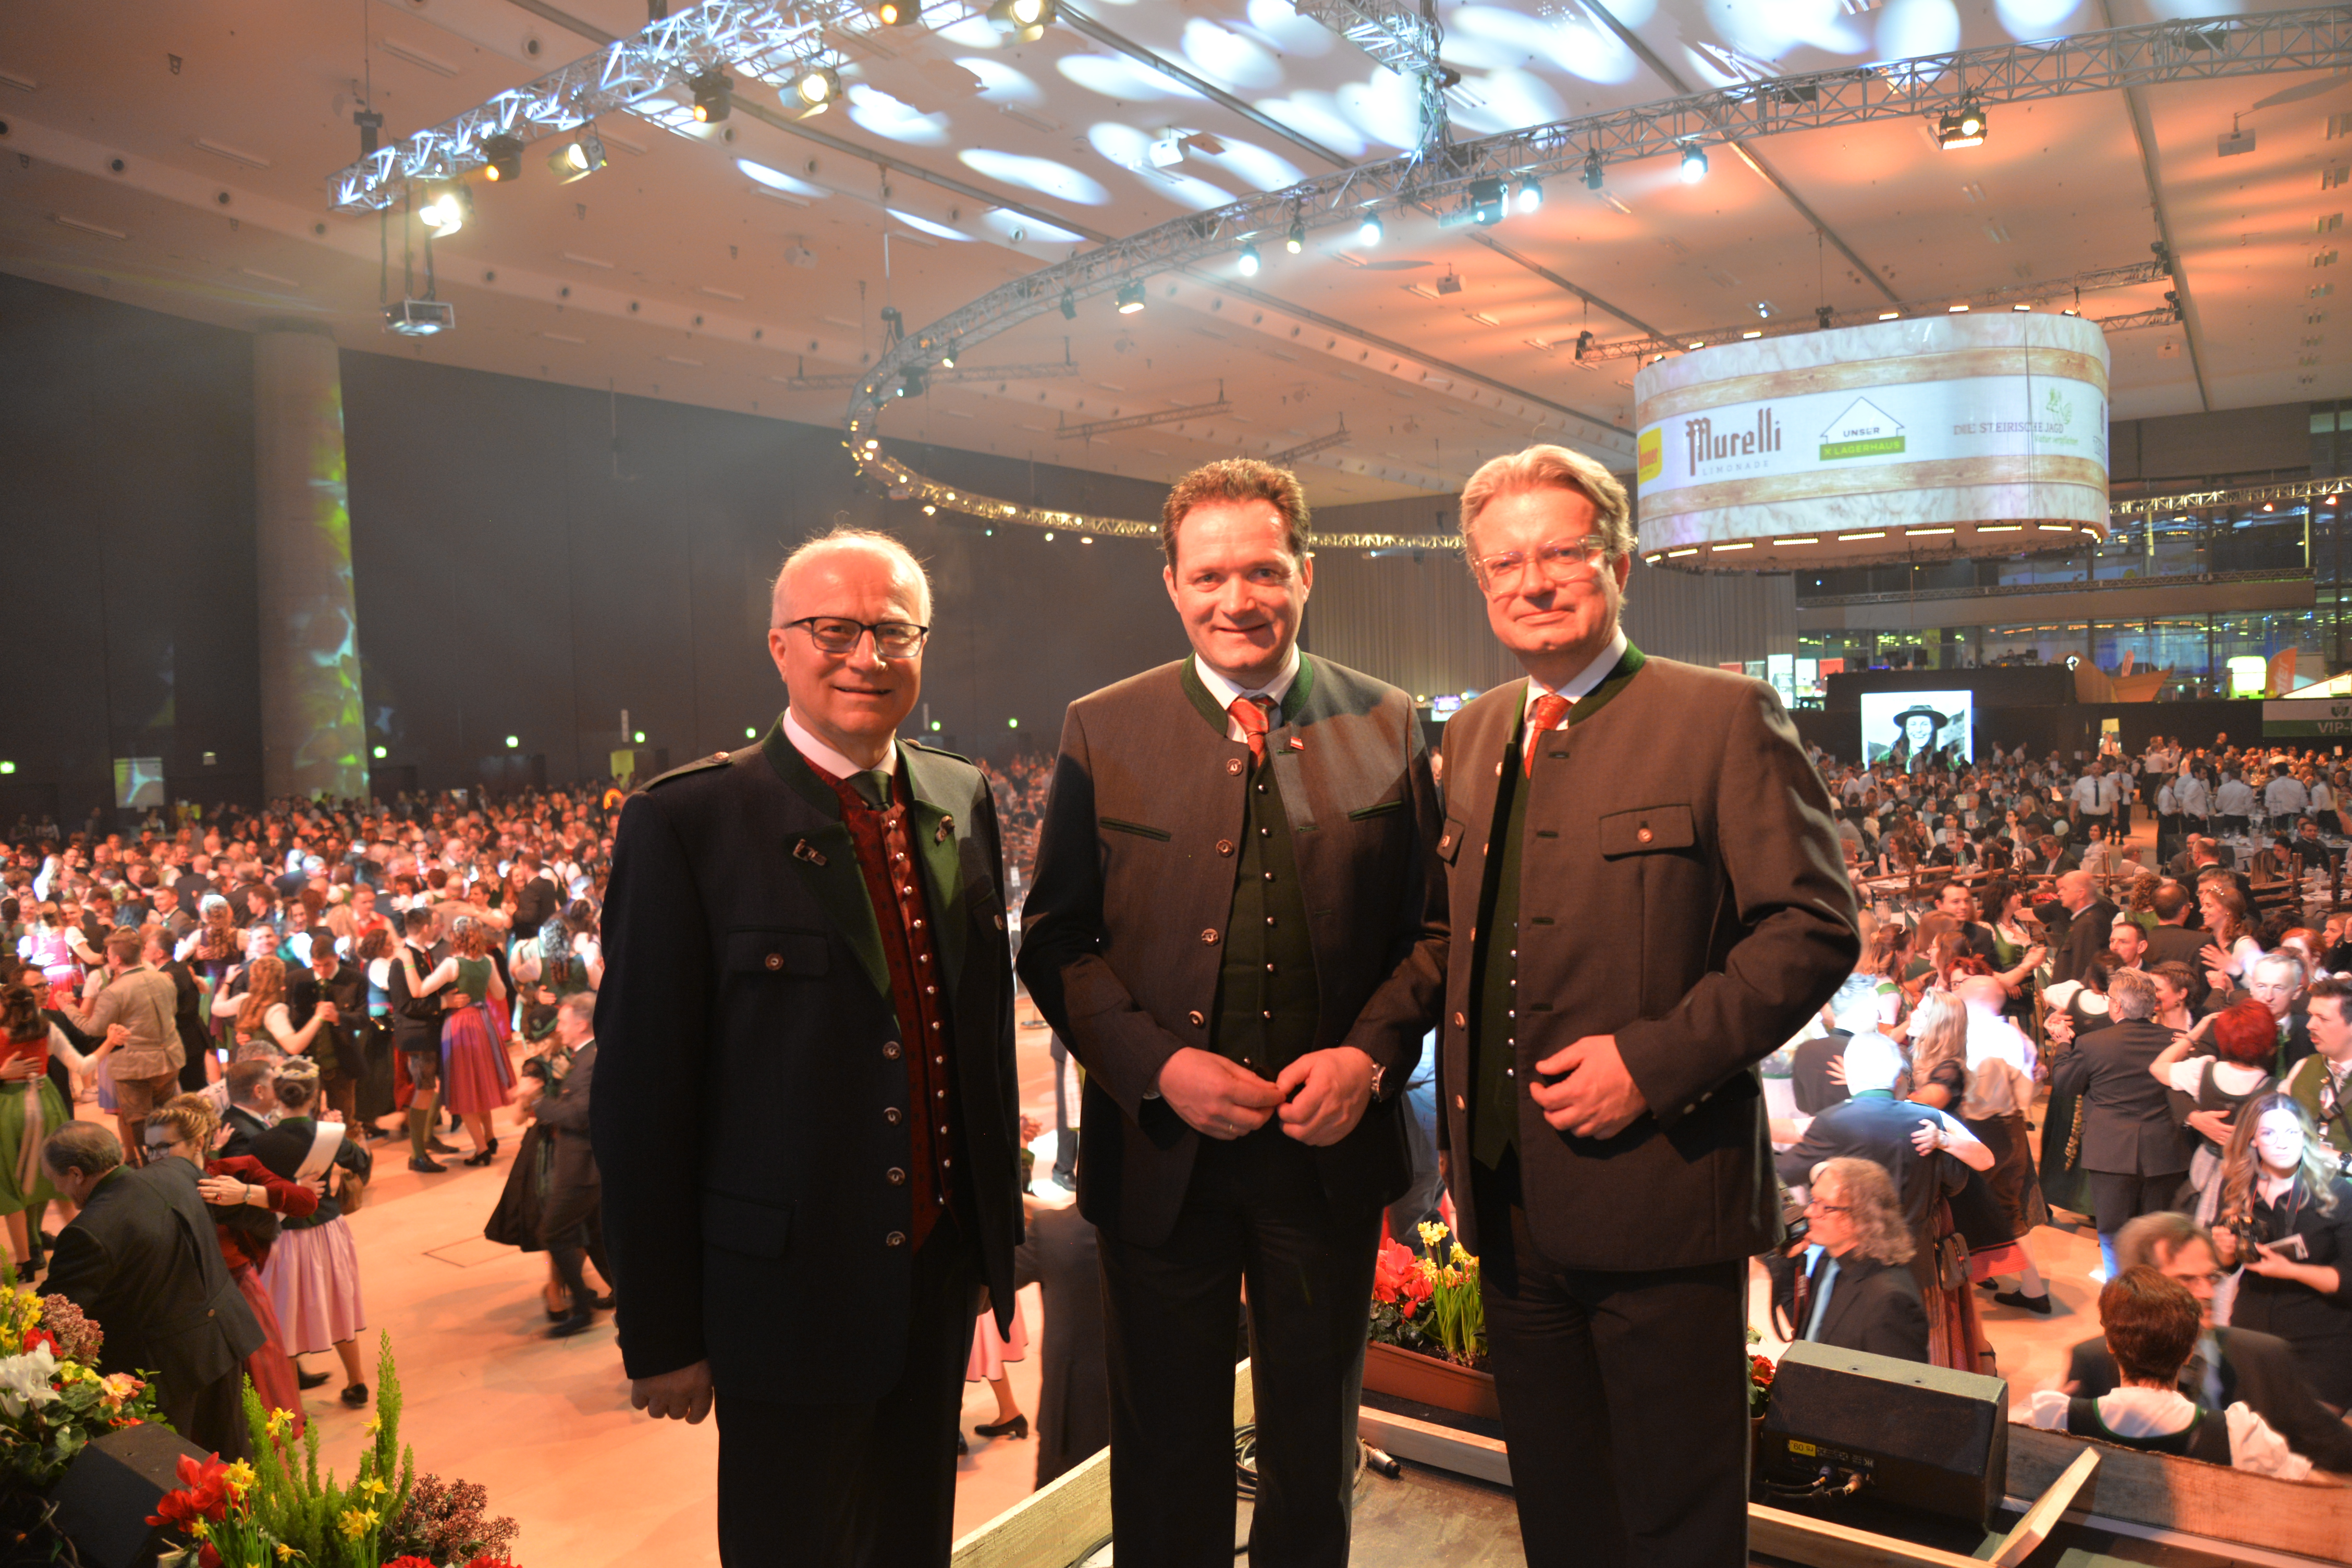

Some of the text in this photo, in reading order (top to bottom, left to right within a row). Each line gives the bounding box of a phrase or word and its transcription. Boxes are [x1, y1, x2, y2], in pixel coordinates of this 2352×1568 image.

[1843, 427, 1880, 437] UNSER
[1953, 422, 2064, 435] DIE STEIRISCHE JAGD
[1685, 408, 1781, 476] Murelli
[1834, 441, 1901, 455] LAGERHAUS
[1702, 460, 1769, 475] LIMONADE
[2318, 721, 2352, 733] VIP-
